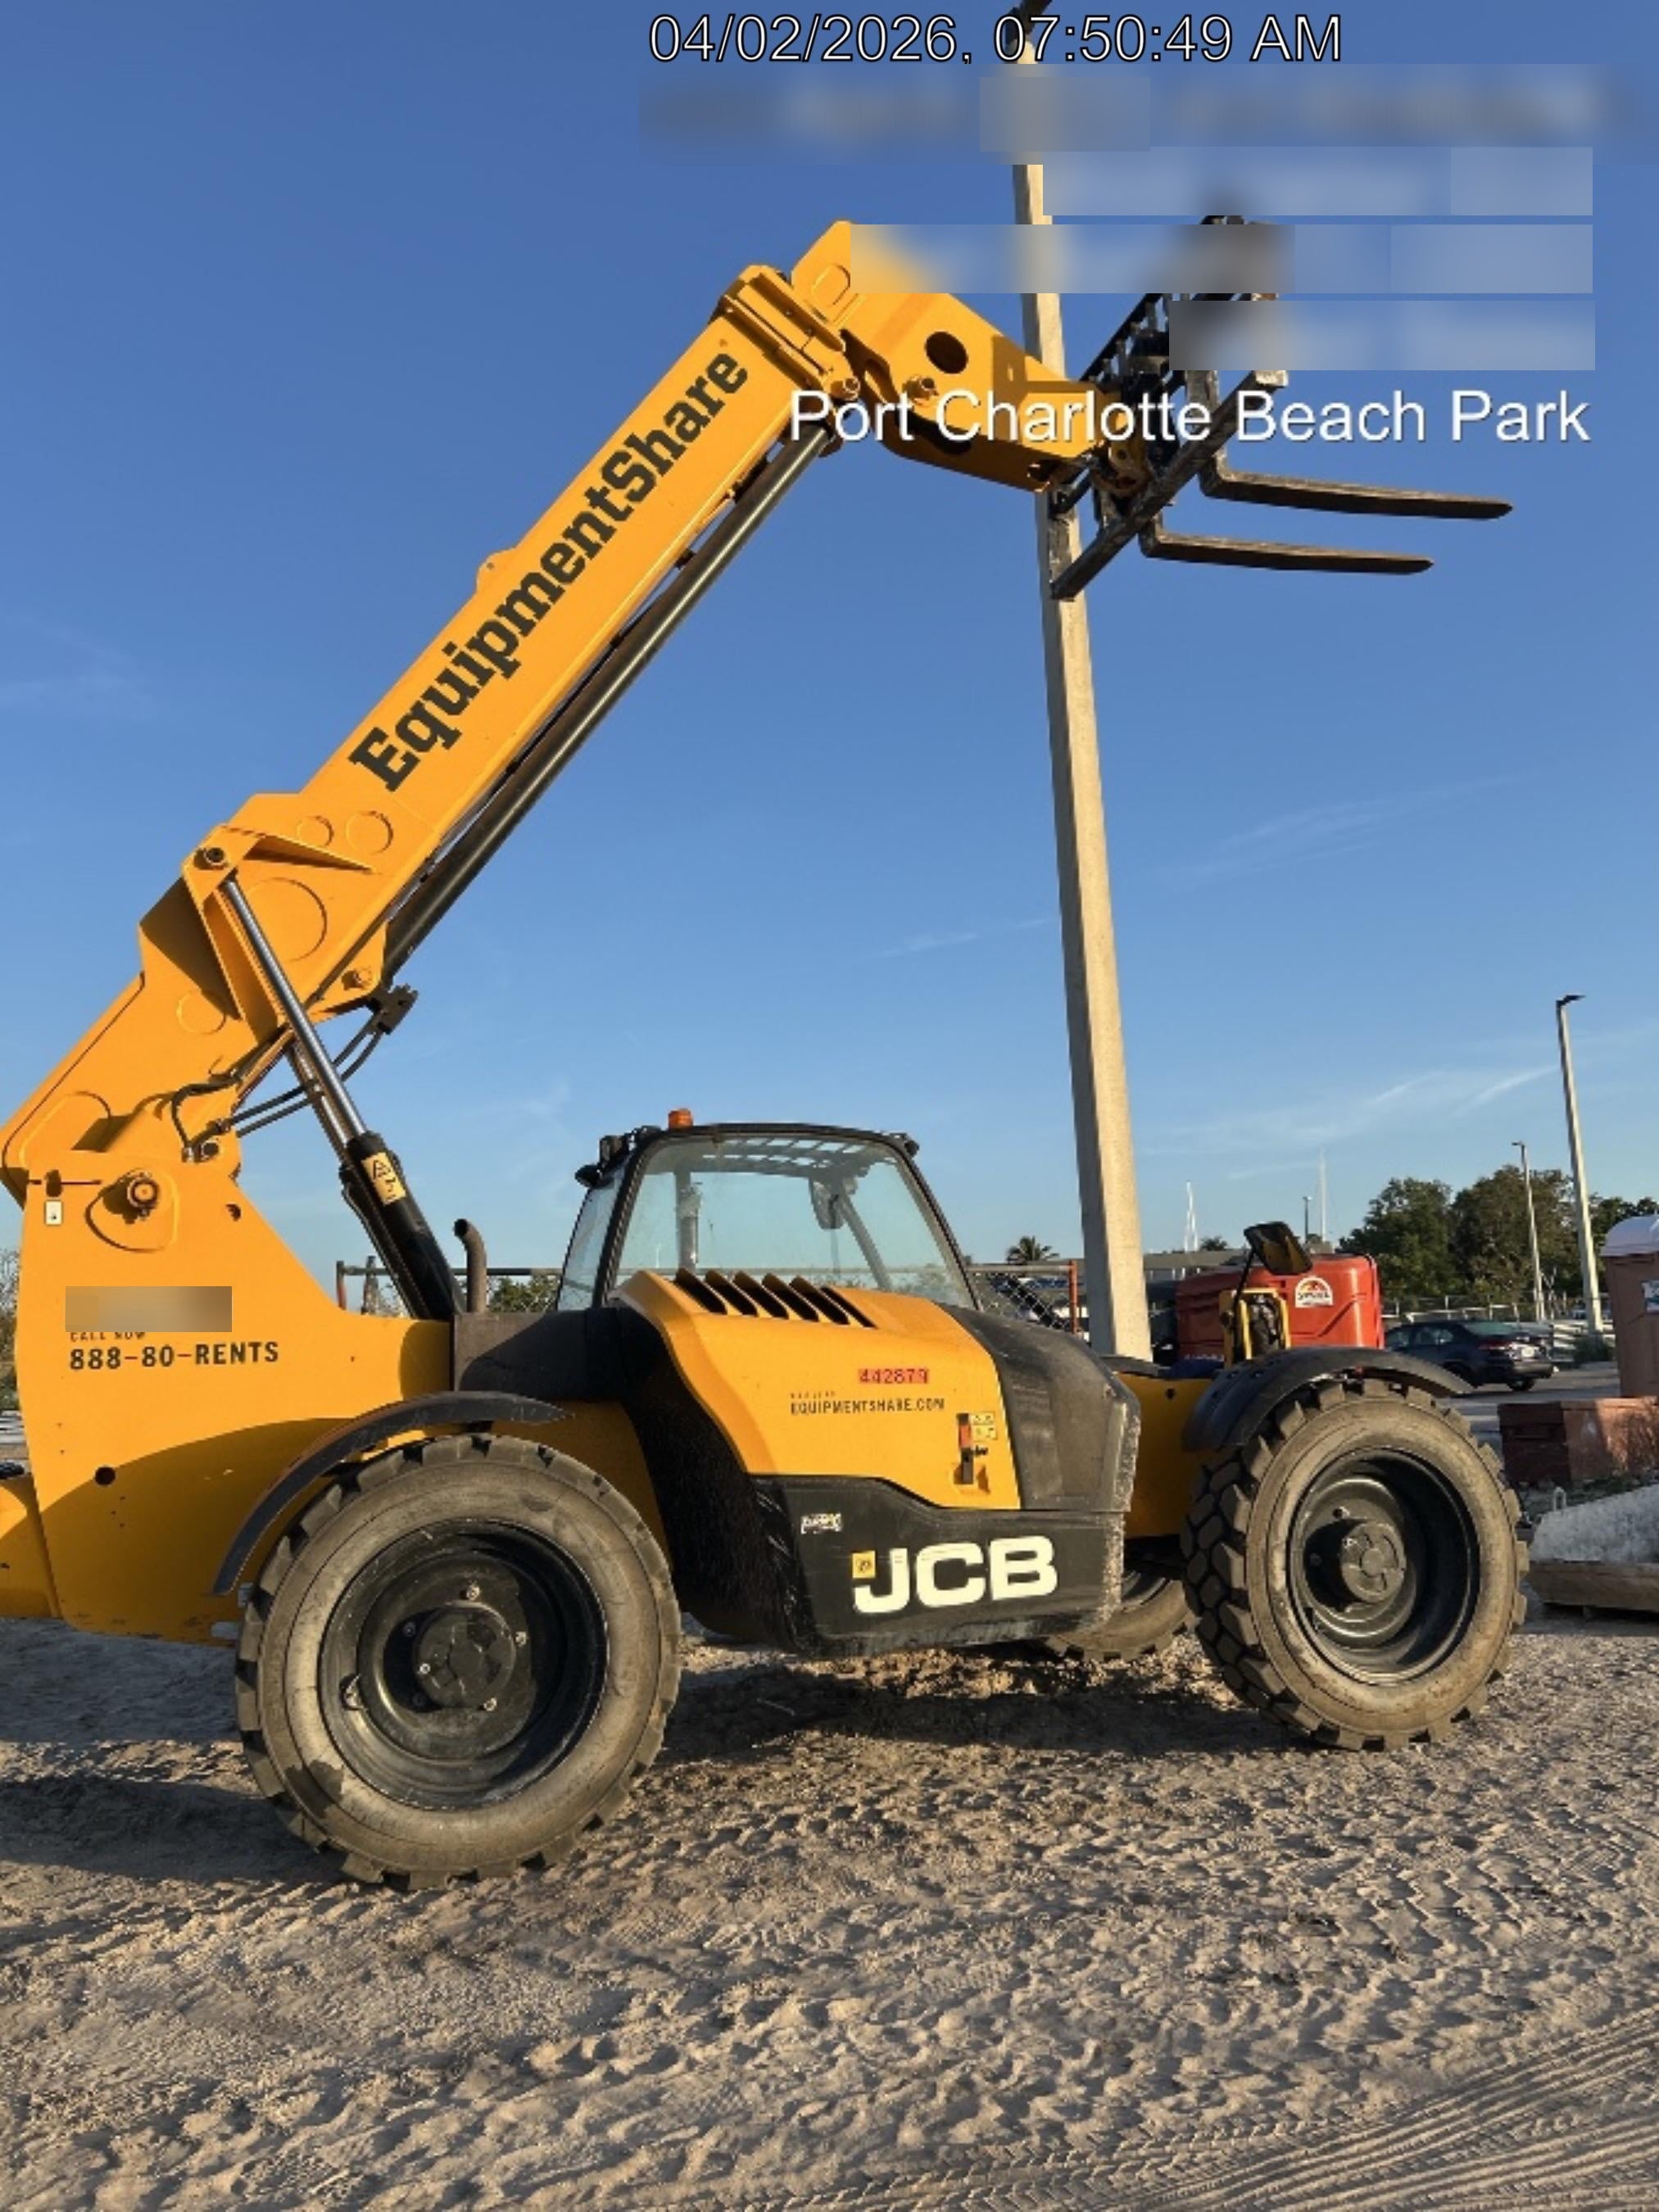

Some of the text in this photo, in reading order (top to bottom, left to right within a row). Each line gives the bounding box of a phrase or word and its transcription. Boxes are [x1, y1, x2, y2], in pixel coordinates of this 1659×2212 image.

[347, 353, 748, 791] EquipmentShare
[70, 1341, 279, 1370] 888-80-RENTS
[791, 1398, 945, 1415] EQUIPMENTSHARE.COM
[853, 1535, 1058, 1613] JCB
